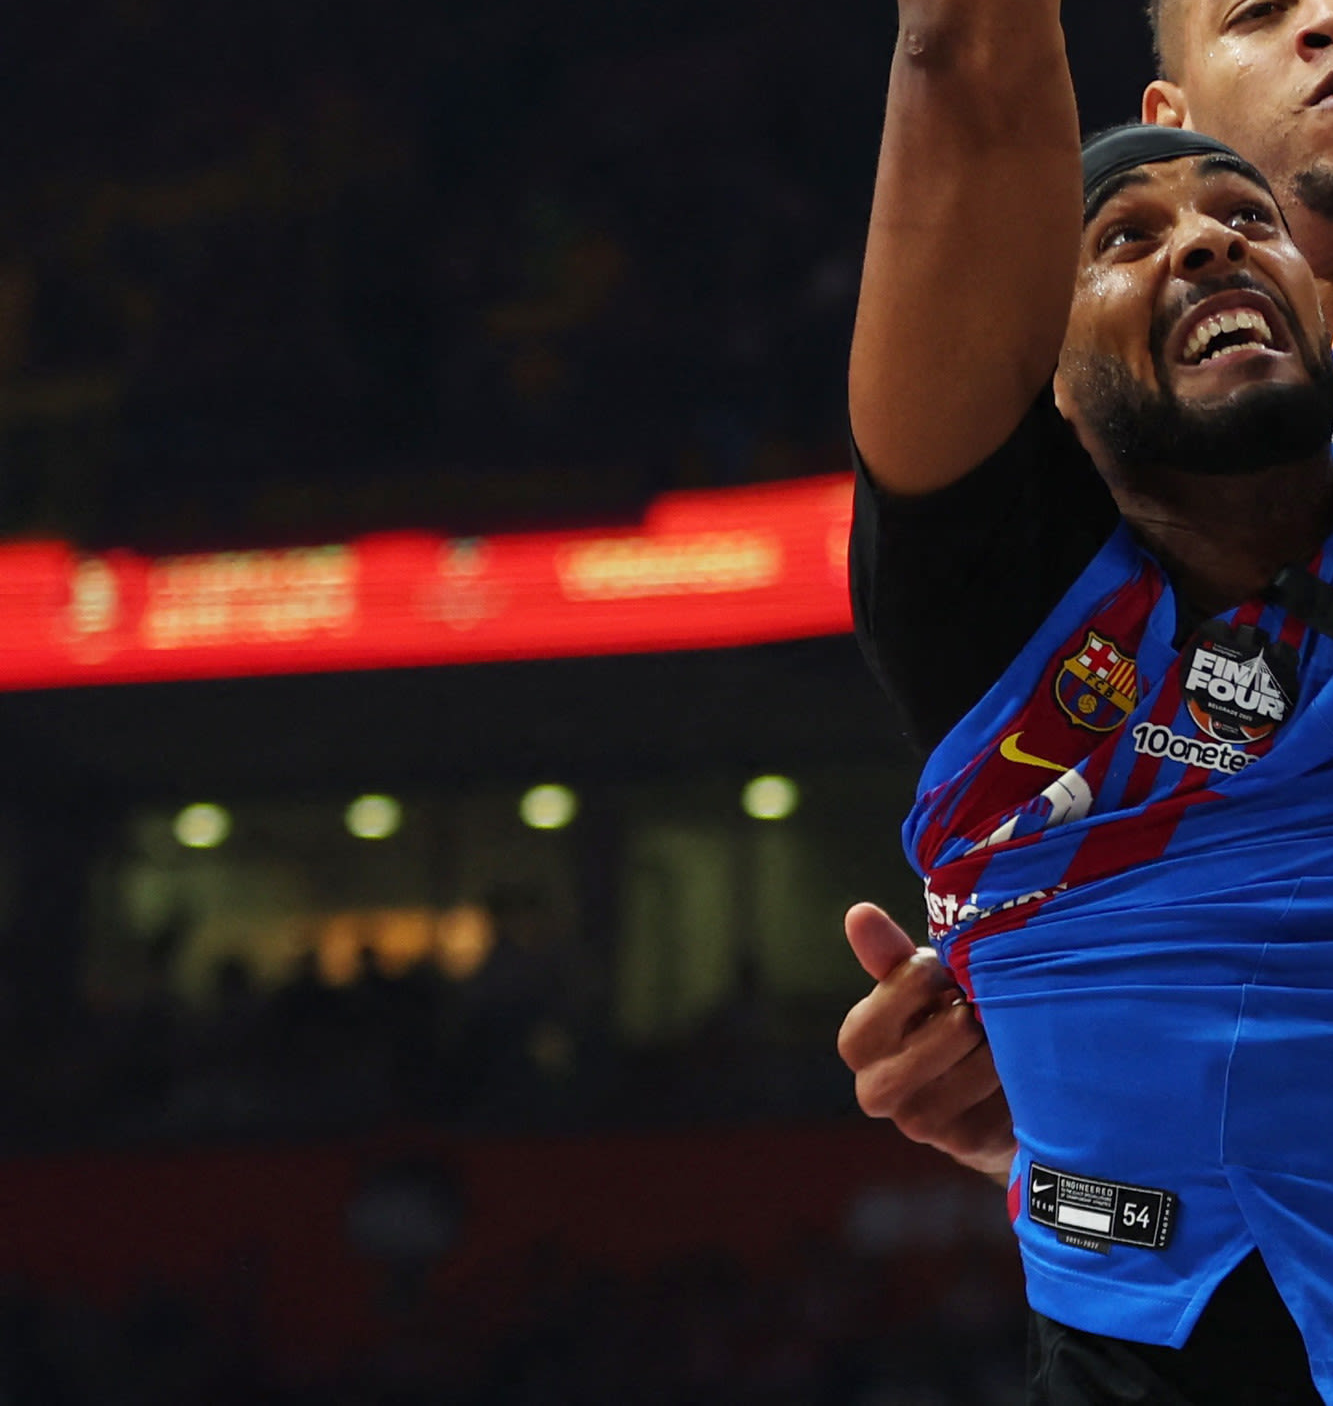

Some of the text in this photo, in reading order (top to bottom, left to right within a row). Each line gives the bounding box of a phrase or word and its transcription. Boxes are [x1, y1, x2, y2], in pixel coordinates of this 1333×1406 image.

[1084, 673, 1115, 699] FCB
[1191, 647, 1281, 700] FINAL
[1184, 667, 1286, 722] FOUR
[1060, 1178, 1113, 1197] ENGINEERED
[1122, 1202, 1150, 1230] 54
